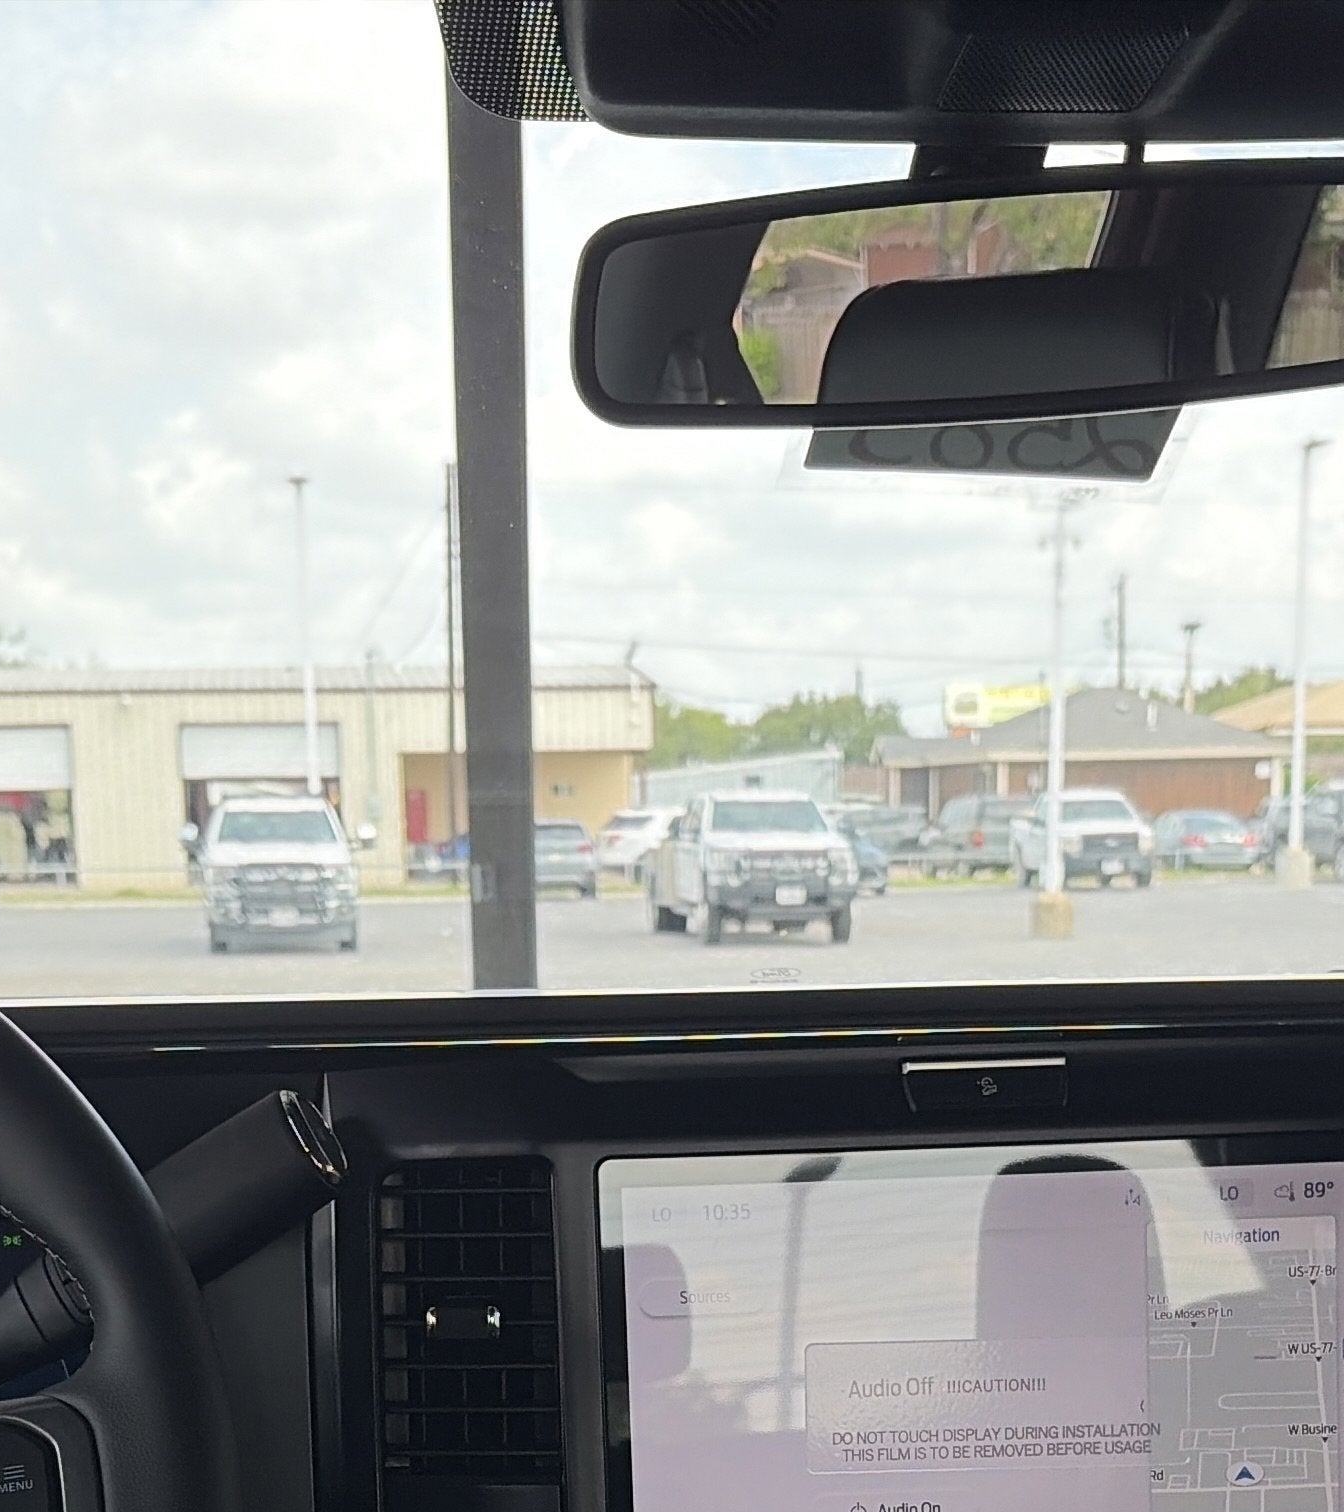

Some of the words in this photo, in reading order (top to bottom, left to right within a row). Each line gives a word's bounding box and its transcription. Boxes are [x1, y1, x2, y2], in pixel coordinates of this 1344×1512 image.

[1219, 1186, 1239, 1201] LO
[1303, 1181, 1334, 1199] 89°
[702, 1203, 751, 1221] 10:35
[1204, 1228, 1280, 1245] Navigation
[679, 1289, 731, 1305] Sources
[1174, 1308, 1206, 1320] Moses
[1221, 1307, 1233, 1318] Ln
[1288, 1343, 1300, 1354] W
[848, 1379, 902, 1399] Audio
[906, 1376, 935, 1396] Off
[947, 1377, 1047, 1394] !!!CAUTION!!!
[832, 1431, 853, 1445] DO
[856, 1430, 885, 1445] NOT
[889, 1429, 940, 1444] TOUCH
[943, 1427, 1001, 1442] DISPLAY
[1004, 1425, 1059, 1440] DURING
[1062, 1422, 1161, 1439] INSTALLATION
[1288, 1425, 1300, 1436] W
[1301, 1423, 1337, 1436] Busine
[842, 1448, 875, 1462] THIS
[877, 1446, 911, 1462] FILM
[914, 1446, 927, 1460] IS
[930, 1445, 950, 1460] TO
[953, 1445, 971, 1459] BE
[974, 1443, 1044, 1458] REMOVED
[1046, 1441, 1102, 1456] BEFORE
[1104, 1439, 1153, 1454] USAGE
